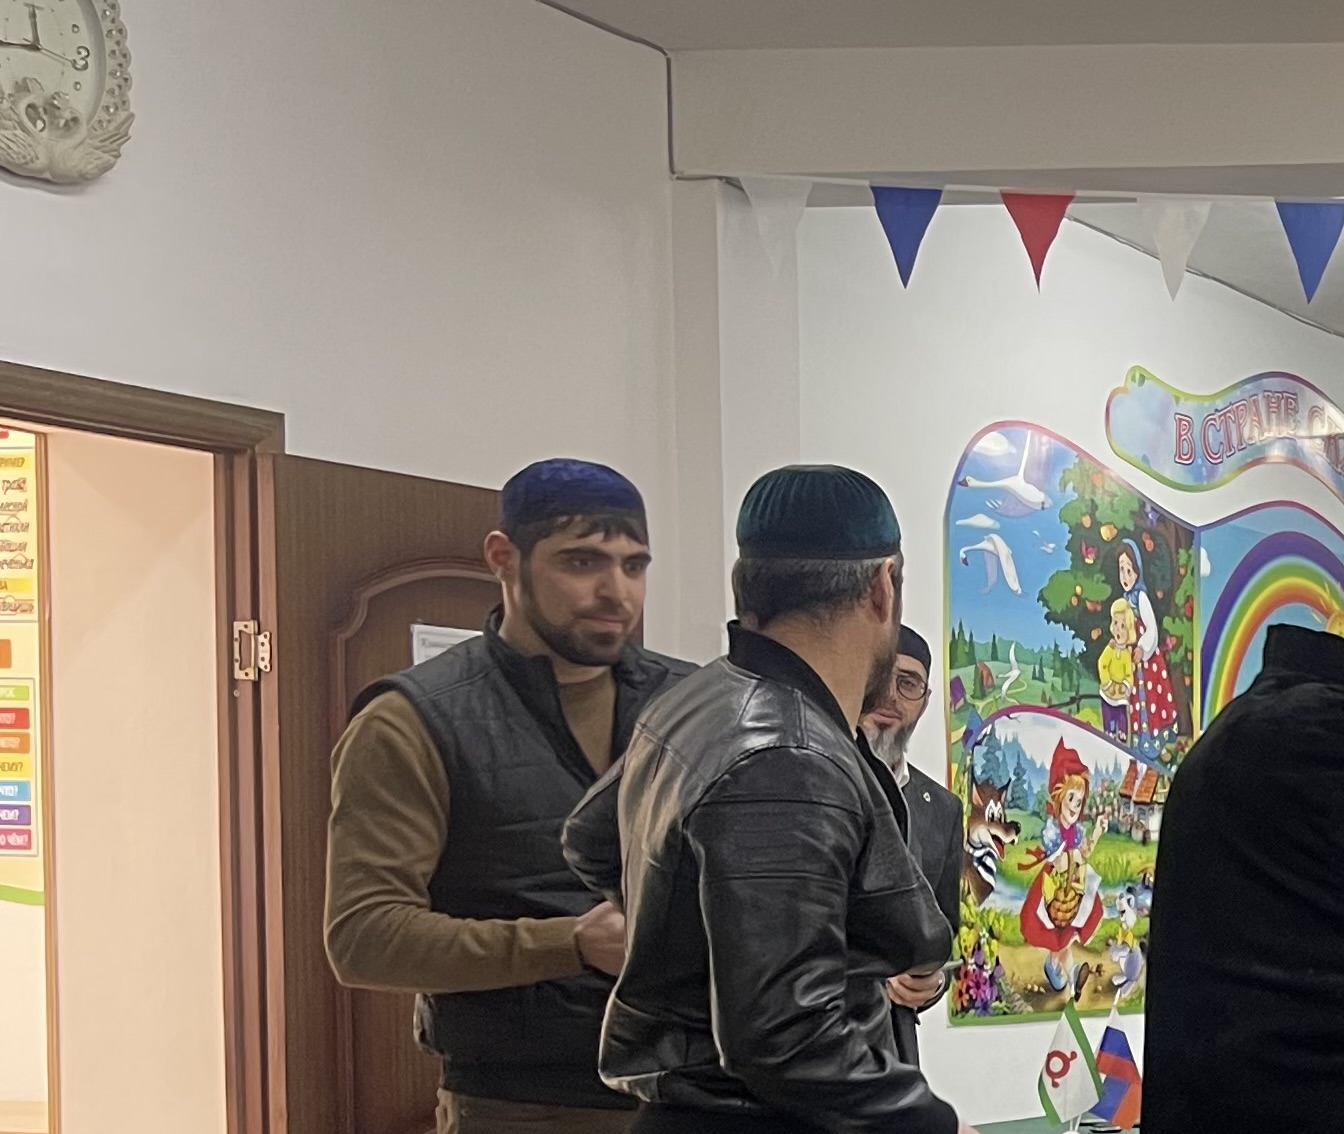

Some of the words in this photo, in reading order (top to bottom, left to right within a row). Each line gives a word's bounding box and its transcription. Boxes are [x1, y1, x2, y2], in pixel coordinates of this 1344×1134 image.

[72, 46, 90, 71] 3
[1174, 413, 1196, 466] В
[1201, 391, 1300, 466] СТРАНЕ
